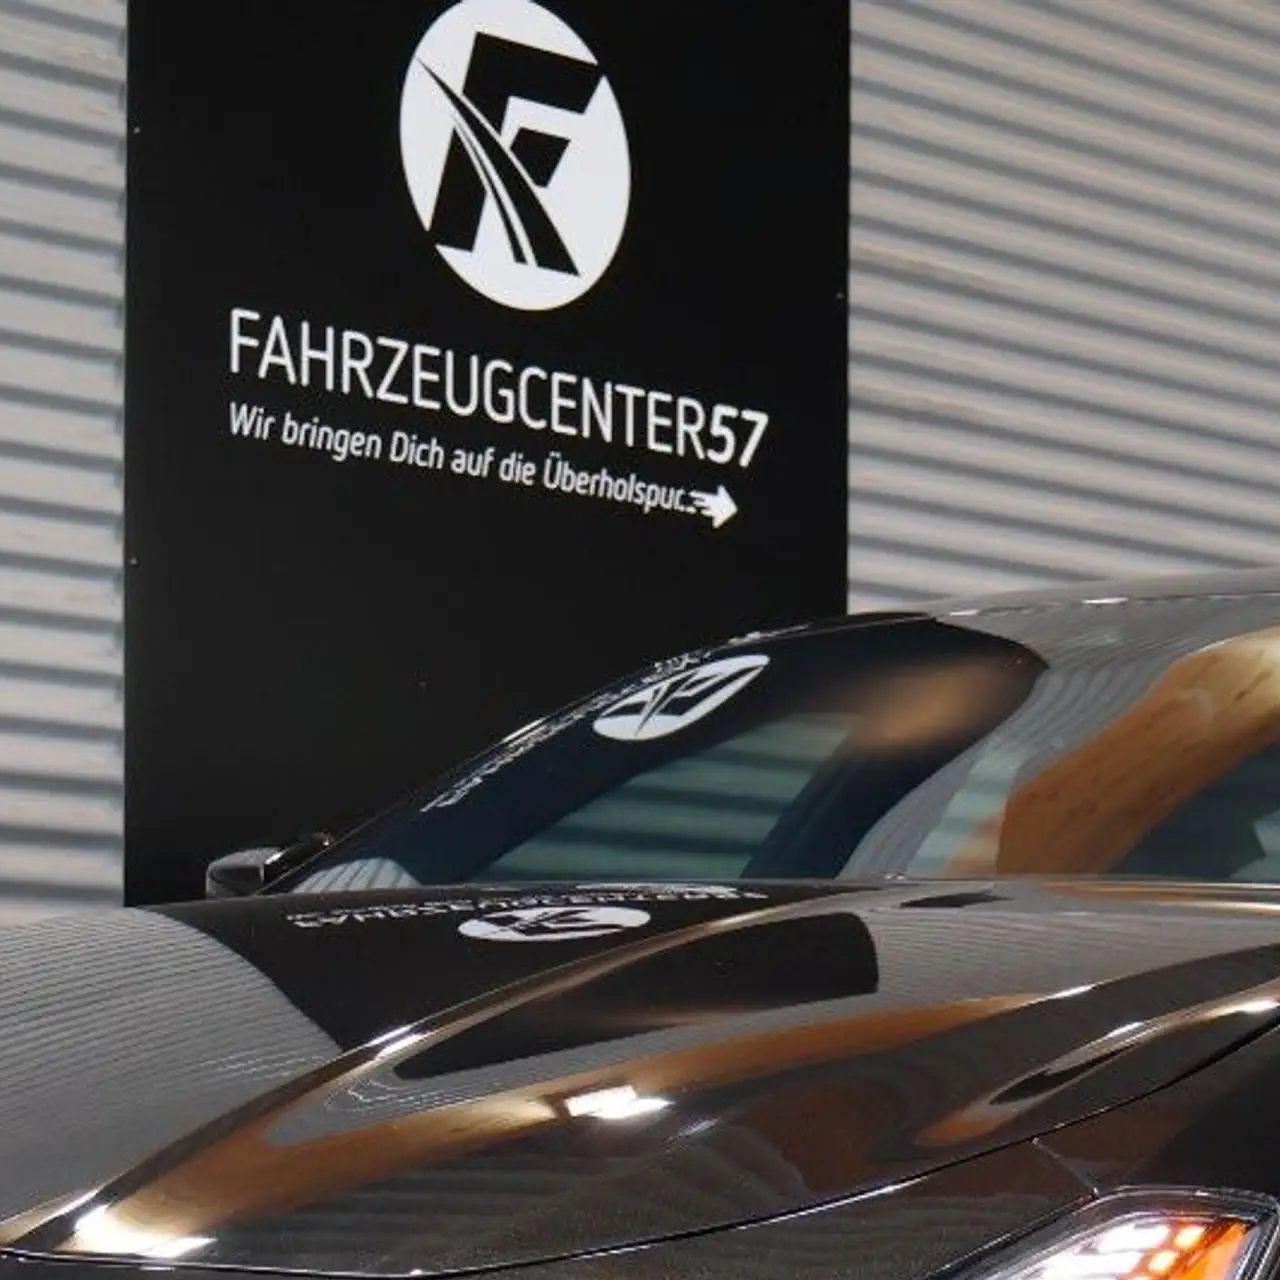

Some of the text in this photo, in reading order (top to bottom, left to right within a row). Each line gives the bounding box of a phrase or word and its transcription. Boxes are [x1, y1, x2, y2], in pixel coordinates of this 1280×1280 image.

[229, 308, 769, 469] FAHRZEUGCENTER57
[229, 401, 276, 441] Wir
[281, 411, 382, 463] bringen
[389, 430, 445, 470] Dich
[450, 447, 495, 478] auf
[498, 451, 537, 486] die
